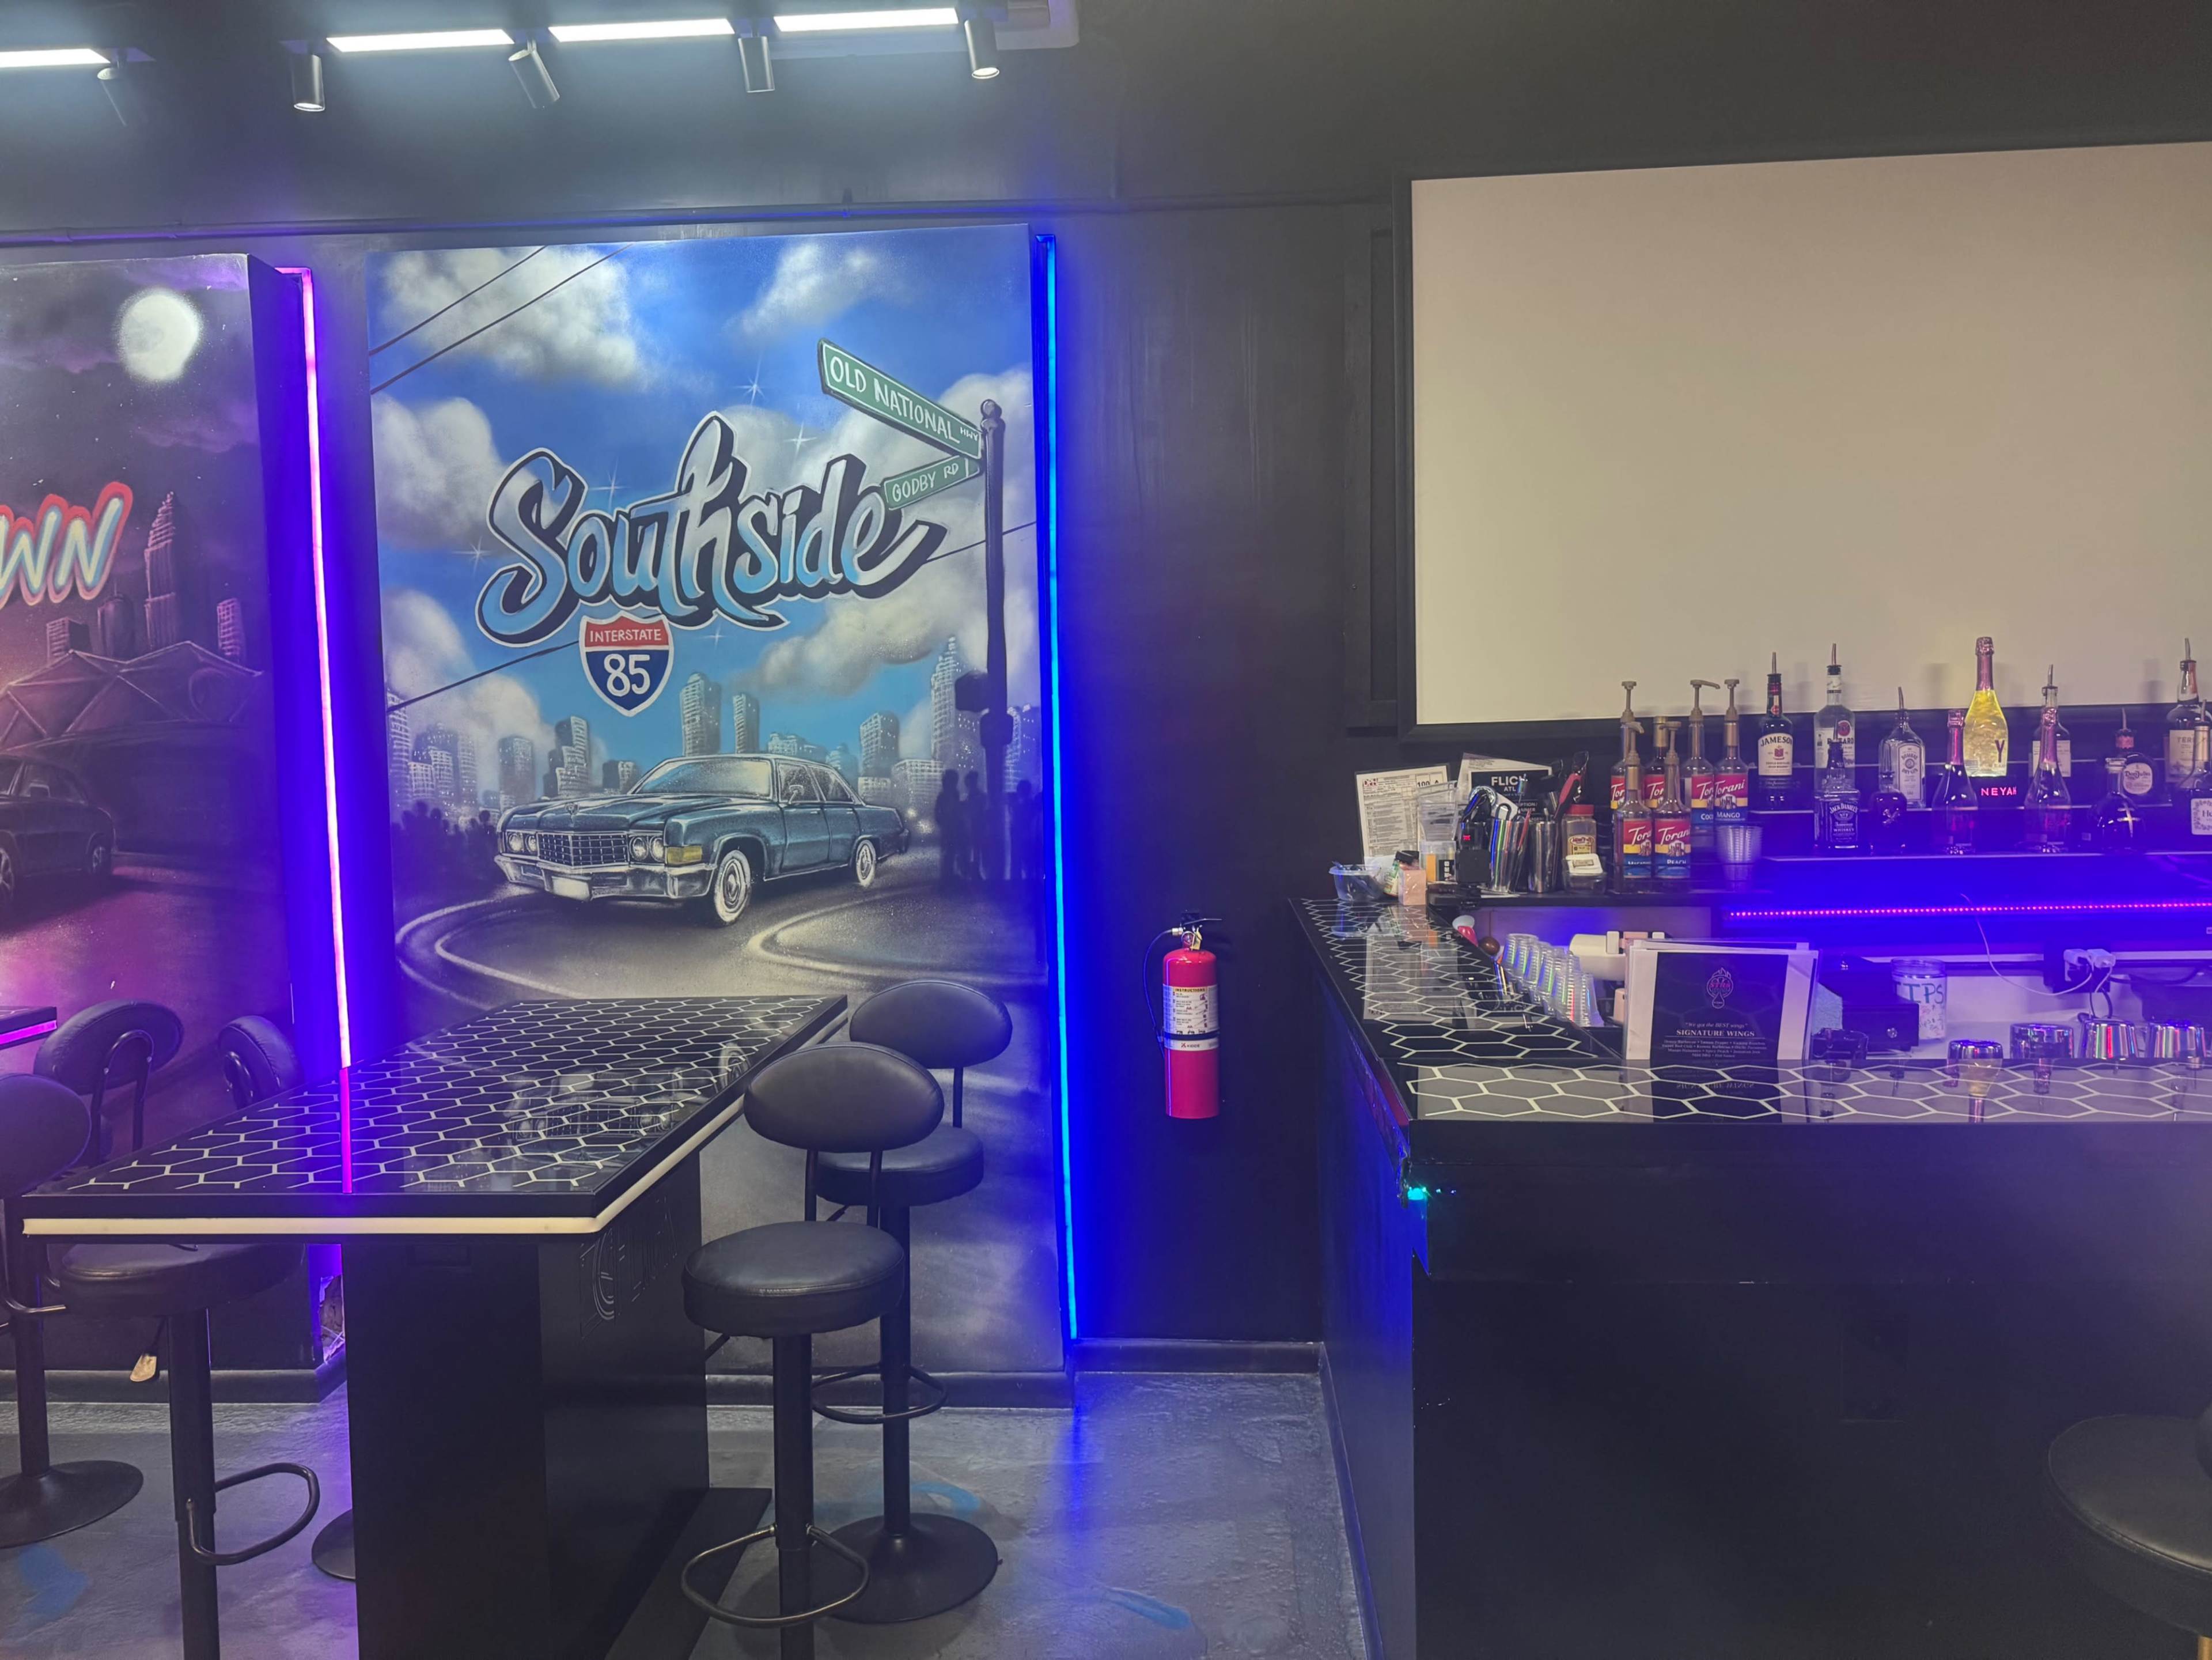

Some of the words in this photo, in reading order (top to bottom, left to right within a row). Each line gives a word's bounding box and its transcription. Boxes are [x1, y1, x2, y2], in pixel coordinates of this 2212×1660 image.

[830, 357, 866, 392] OLD
[873, 377, 960, 444] NATIONAL
[960, 427, 979, 441] HWY
[891, 471, 937, 501] GODBY
[943, 462, 959, 481] RD
[476, 411, 947, 647] Southside
[589, 629, 662, 643] INTERSTATE
[603, 653, 650, 695] 85
[1714, 779, 1745, 799] Torani
[1896, 981, 1944, 1004] IPS
